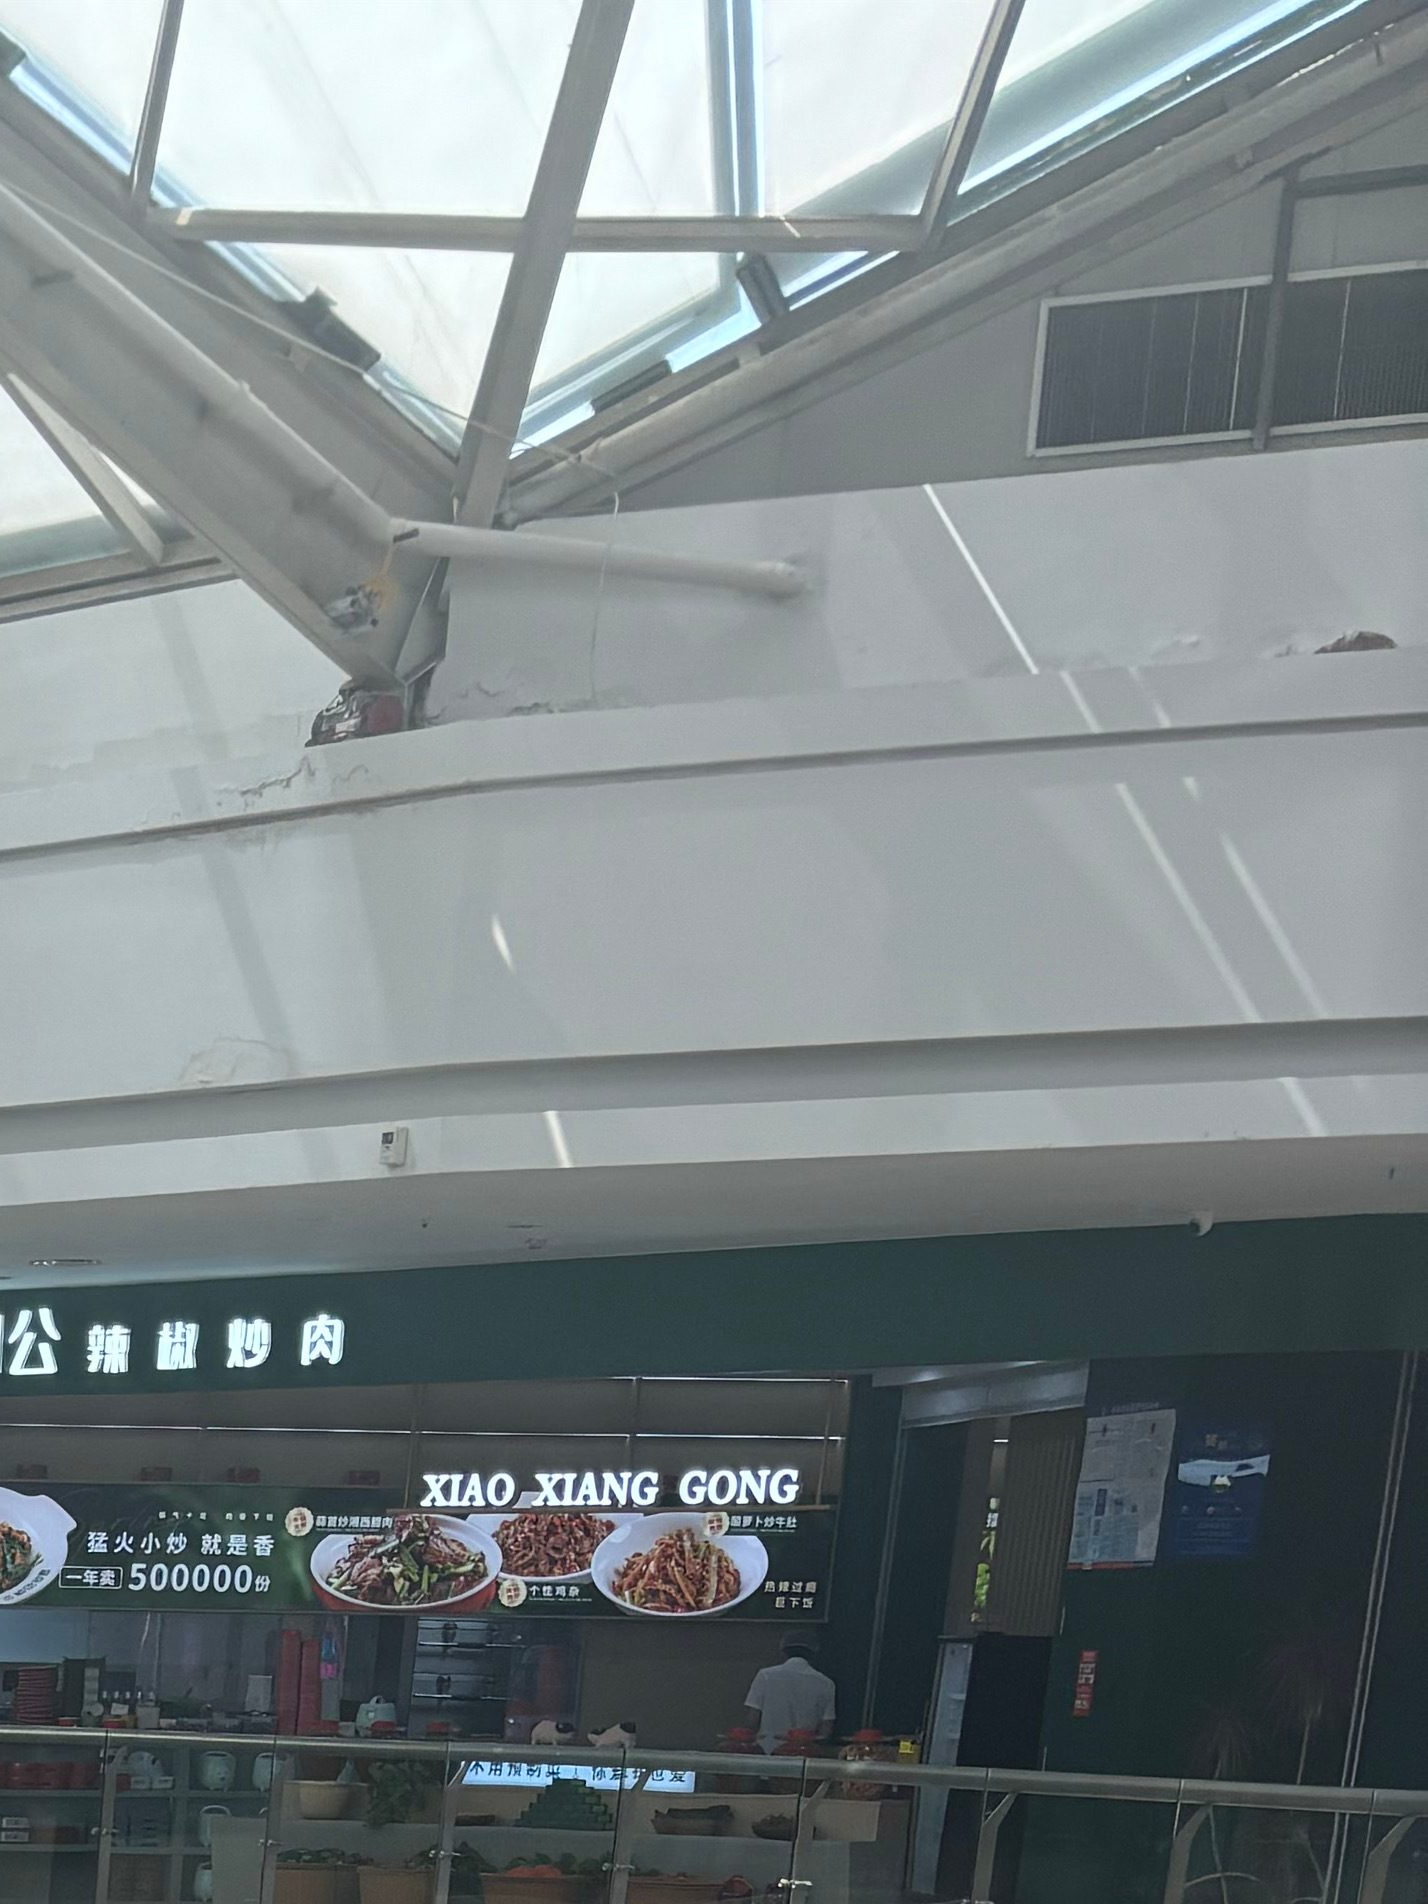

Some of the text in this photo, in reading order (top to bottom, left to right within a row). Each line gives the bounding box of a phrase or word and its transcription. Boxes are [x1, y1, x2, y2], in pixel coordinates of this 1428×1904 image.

[86, 1312, 345, 1373] 辣椒炒肉
[422, 1468, 800, 1509] XIAO XIANG GONG
[87, 1531, 275, 1557] 猛火小炒 就是香
